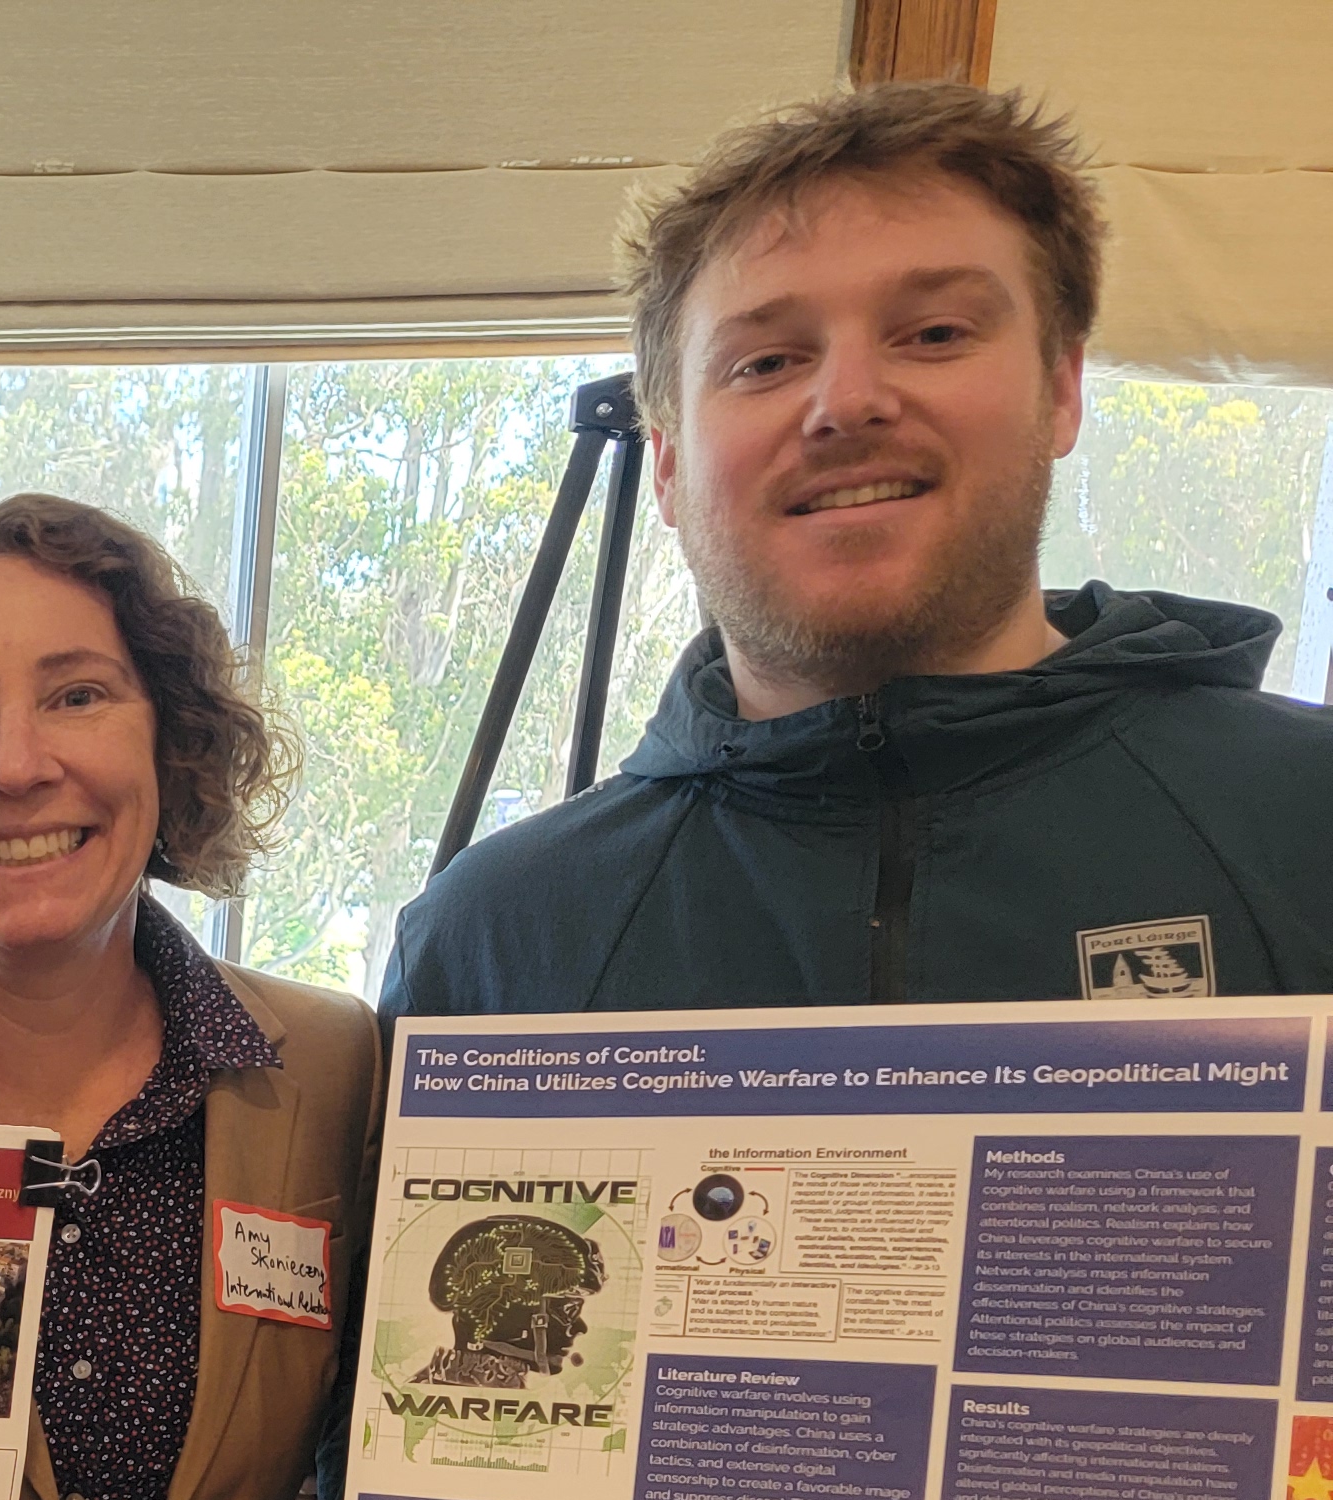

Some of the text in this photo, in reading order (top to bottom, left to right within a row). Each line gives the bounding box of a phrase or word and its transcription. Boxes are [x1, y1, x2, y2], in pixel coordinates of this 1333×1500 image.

[416, 1045, 705, 1065] The Conditions of Control:
[413, 1062, 1289, 1092] How China Utilizes Cognitive Warfare to Enhance Its Geopolitical Might
[709, 1147, 907, 1158] the Information Environment
[986, 1150, 1065, 1163] Methods
[401, 1176, 639, 1204] COGNITIVE
[235, 1220, 271, 1254] Amy
[251, 1246, 327, 1294] Skonieczny
[657, 1368, 800, 1385] Literature Review
[383, 1390, 615, 1428] WARFARE
[963, 1398, 1029, 1414] Results
